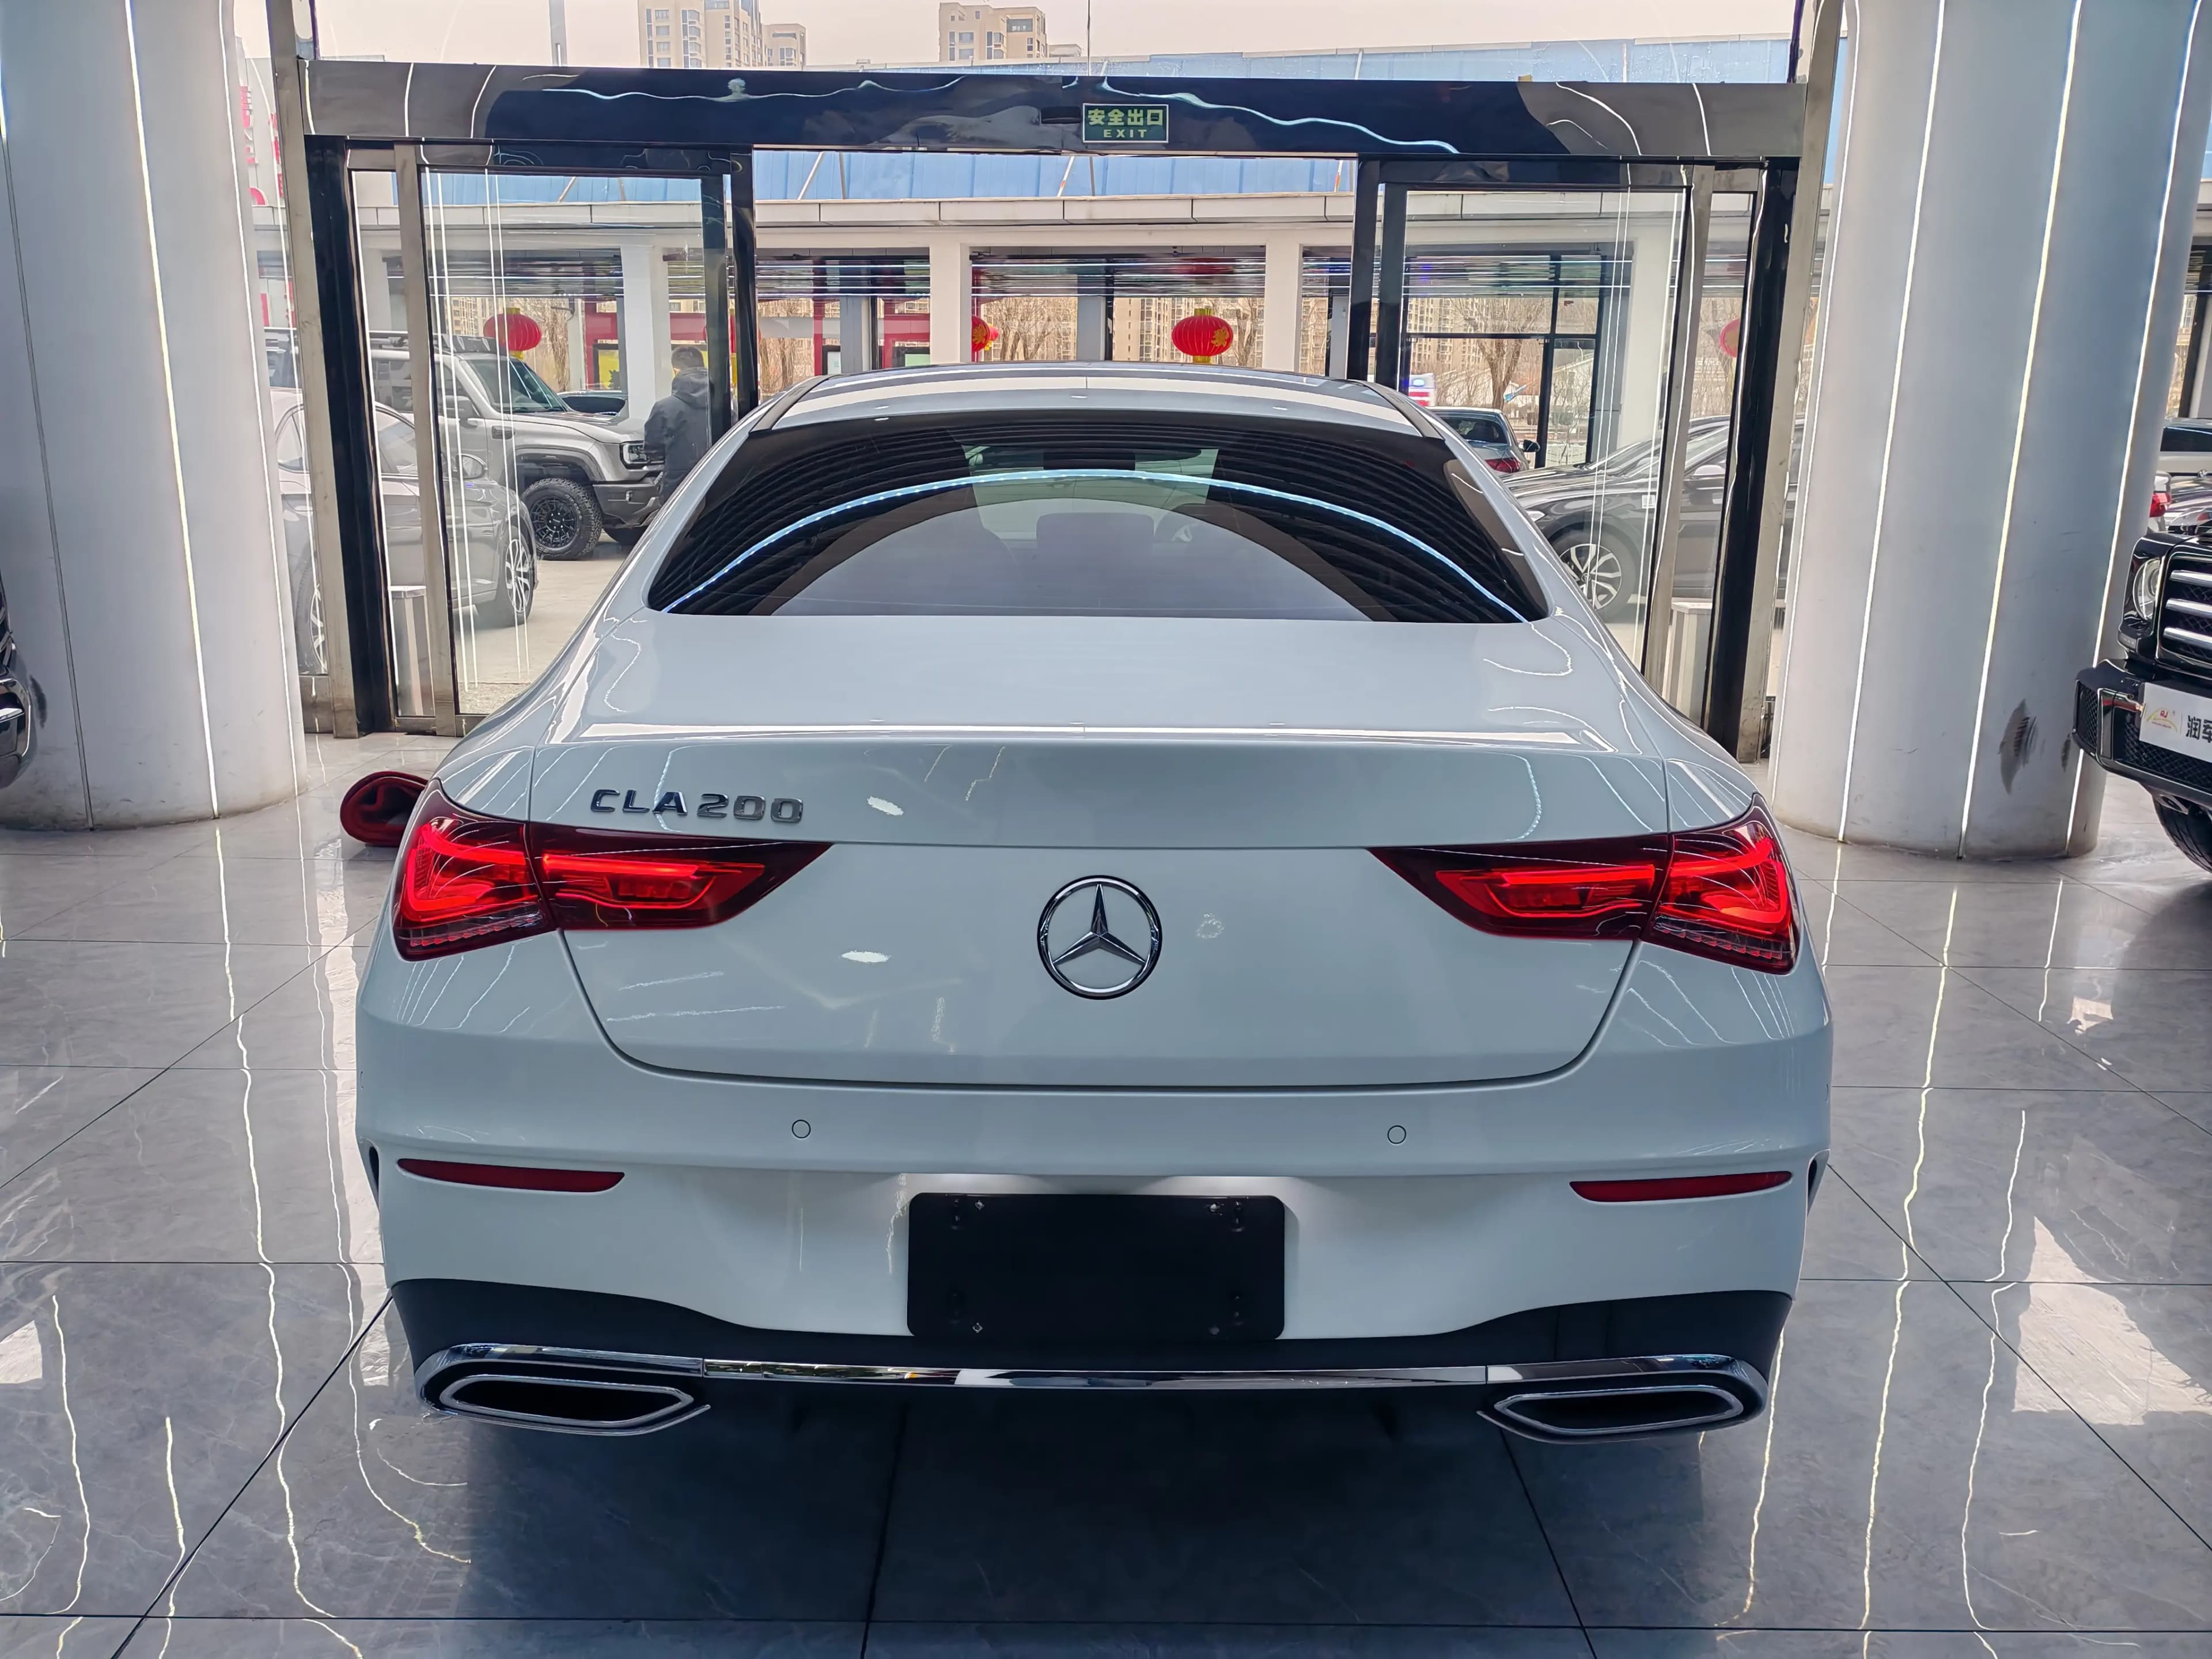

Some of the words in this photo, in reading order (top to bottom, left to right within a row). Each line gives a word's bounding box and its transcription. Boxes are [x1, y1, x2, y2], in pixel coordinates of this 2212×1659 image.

[1088, 108, 1163, 126] 安全出口
[1103, 129, 1147, 138] EXIT
[590, 789, 687, 816] CLA
[696, 793, 804, 823] 200
